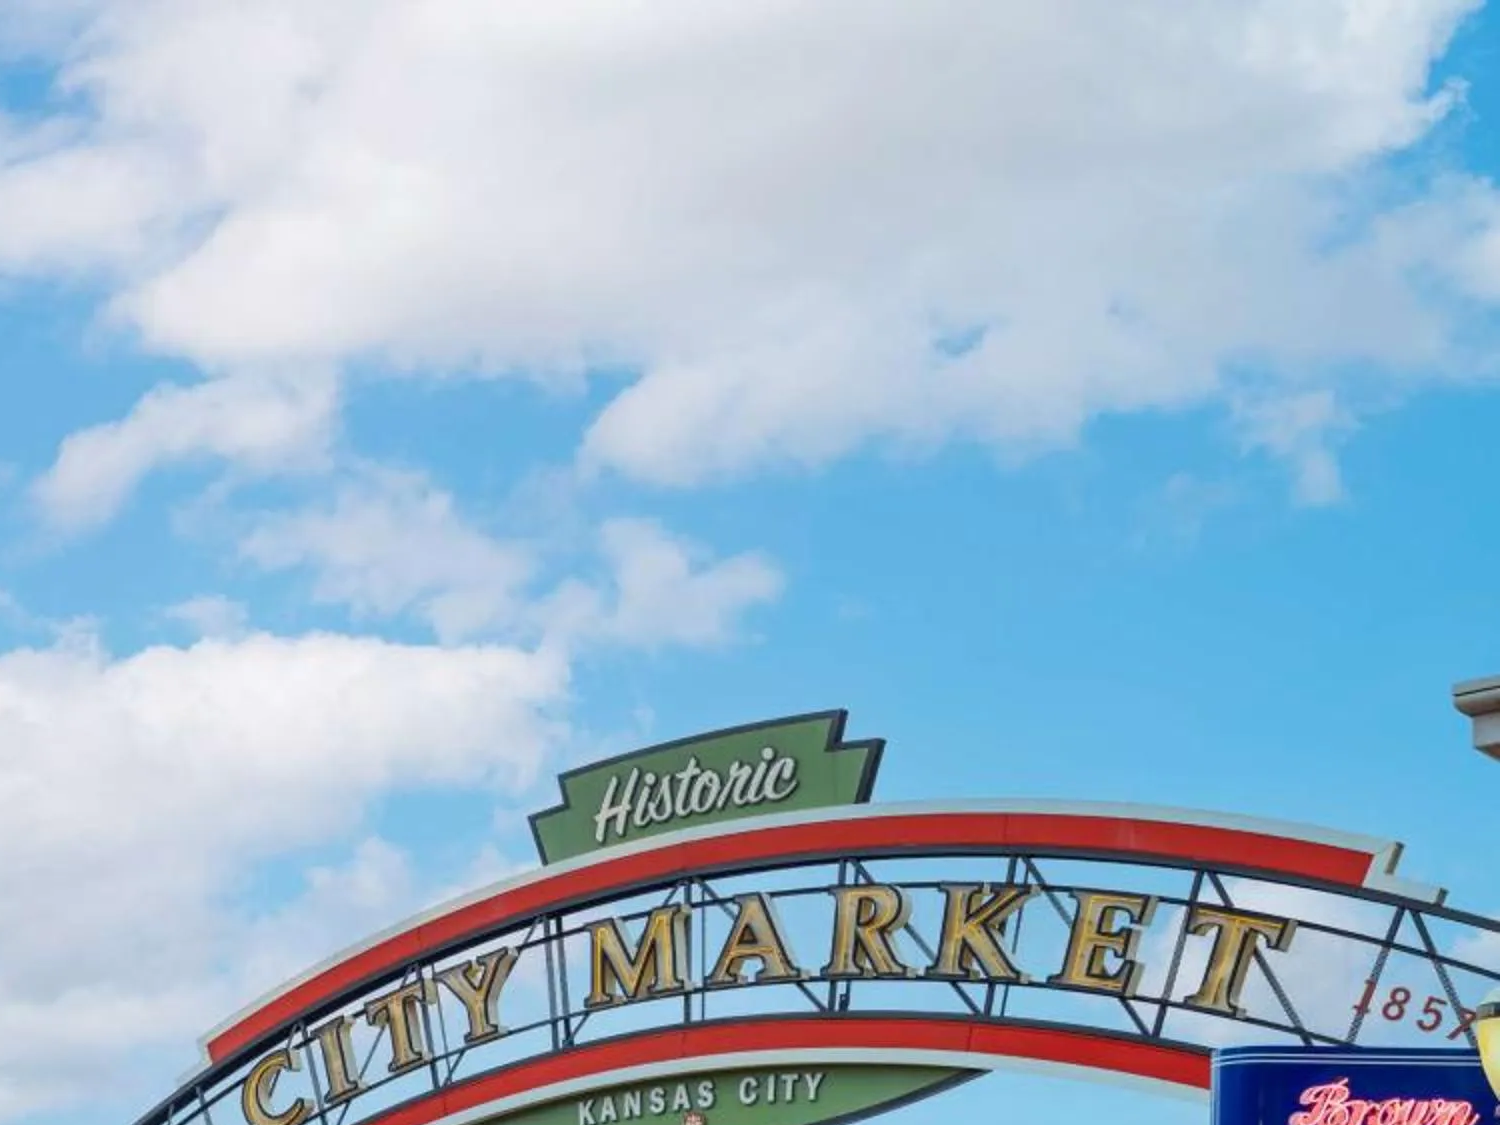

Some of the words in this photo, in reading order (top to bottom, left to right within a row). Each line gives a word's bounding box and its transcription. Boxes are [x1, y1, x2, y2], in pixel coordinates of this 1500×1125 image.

[593, 746, 798, 843] Historic
[583, 882, 1298, 1018] MARKET
[738, 1072, 825, 1105] CITY
